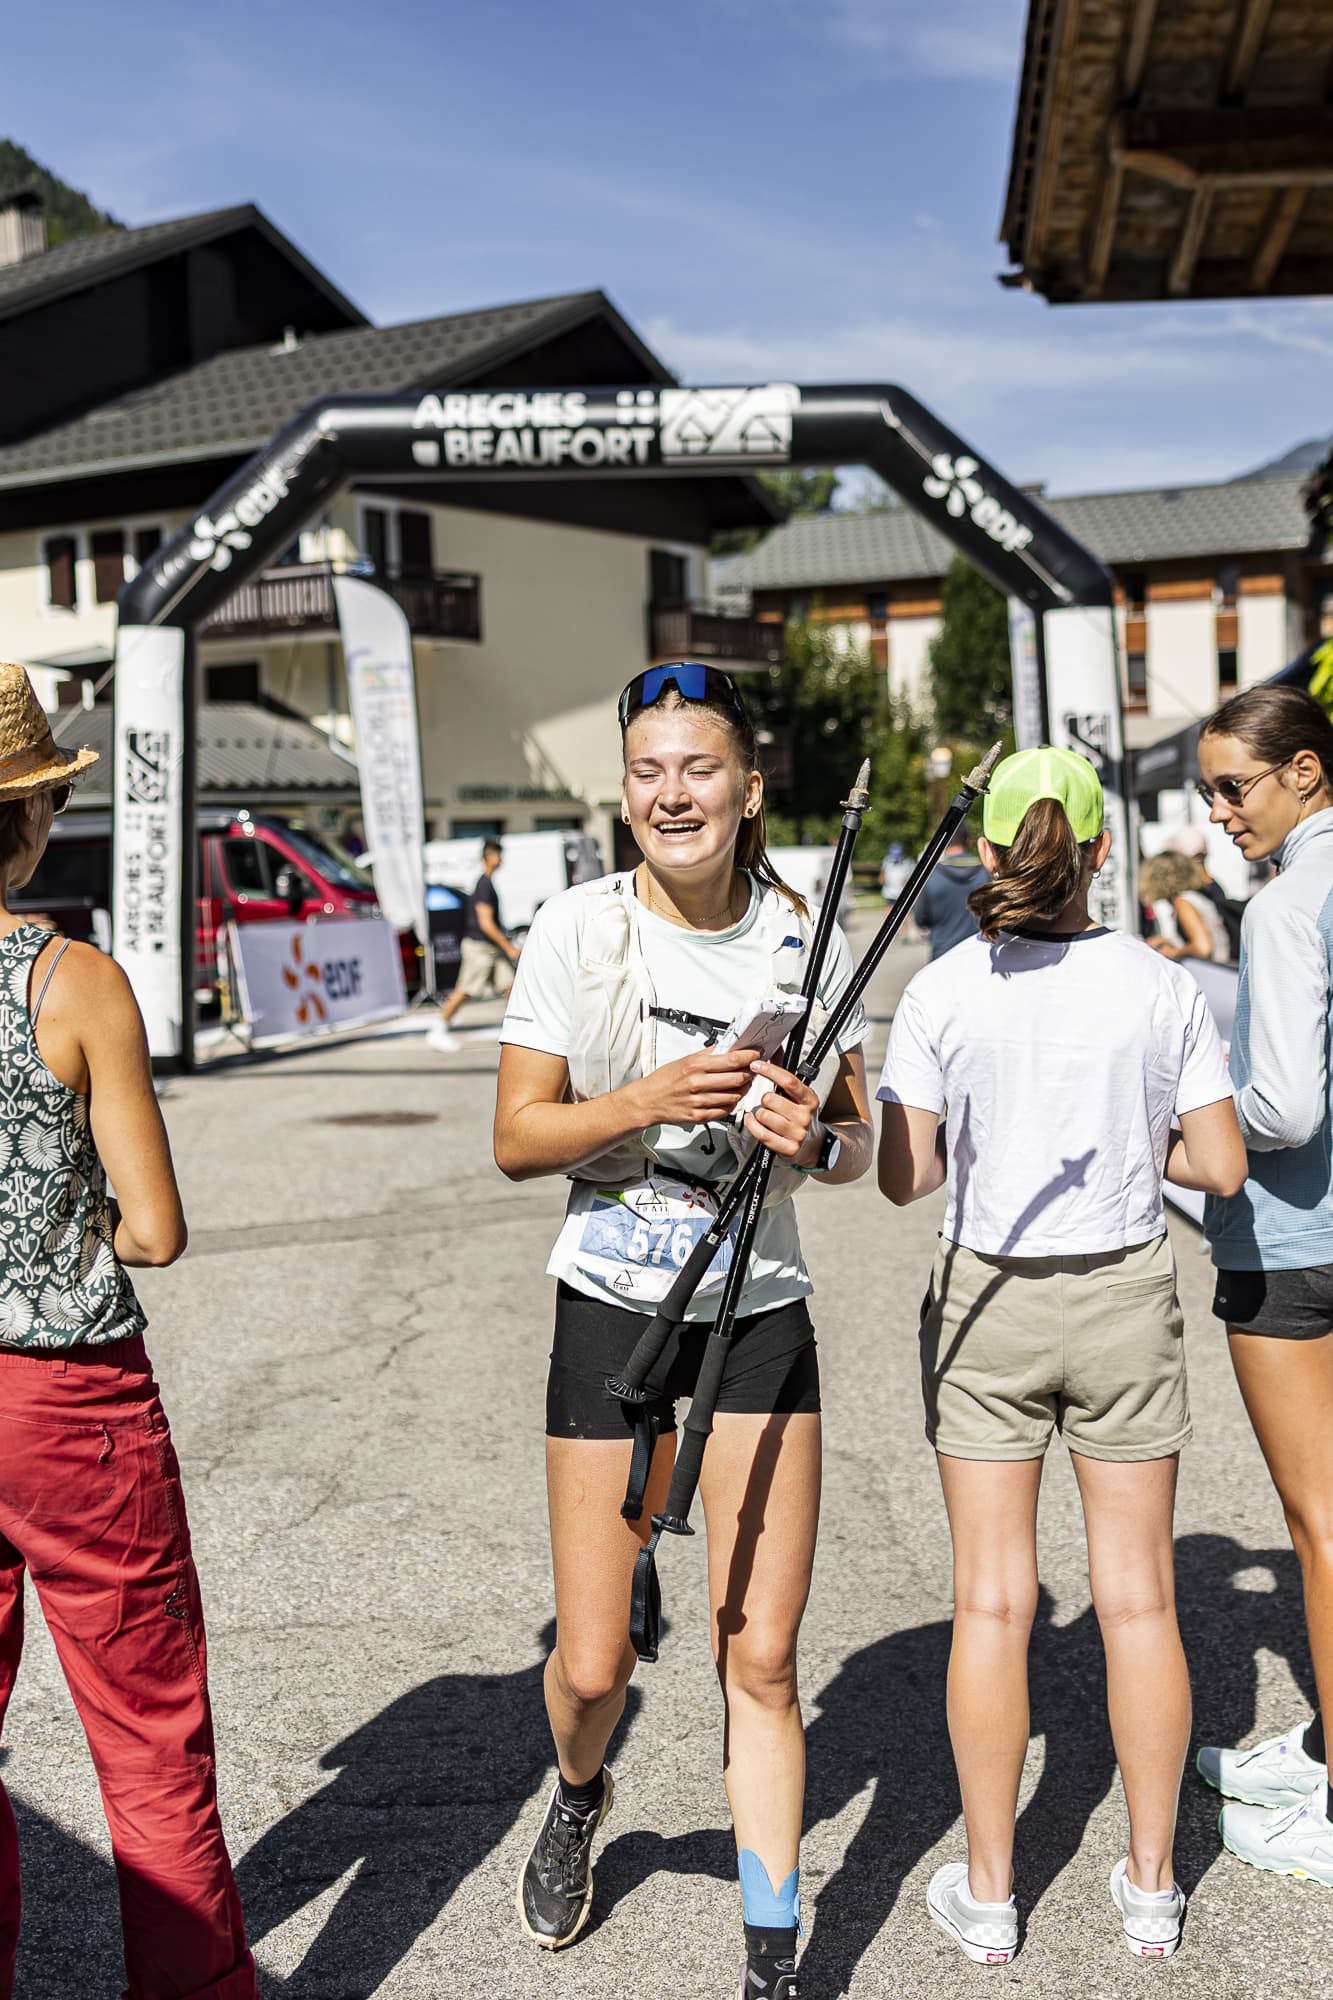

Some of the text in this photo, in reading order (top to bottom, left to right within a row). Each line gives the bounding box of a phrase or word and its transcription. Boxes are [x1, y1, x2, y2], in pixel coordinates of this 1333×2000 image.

[412, 393, 587, 429] ARECHES
[443, 427, 655, 467] BEAUFORT
[147, 814, 166, 934] BEAUFORT
[628, 1220, 693, 1266] 576
